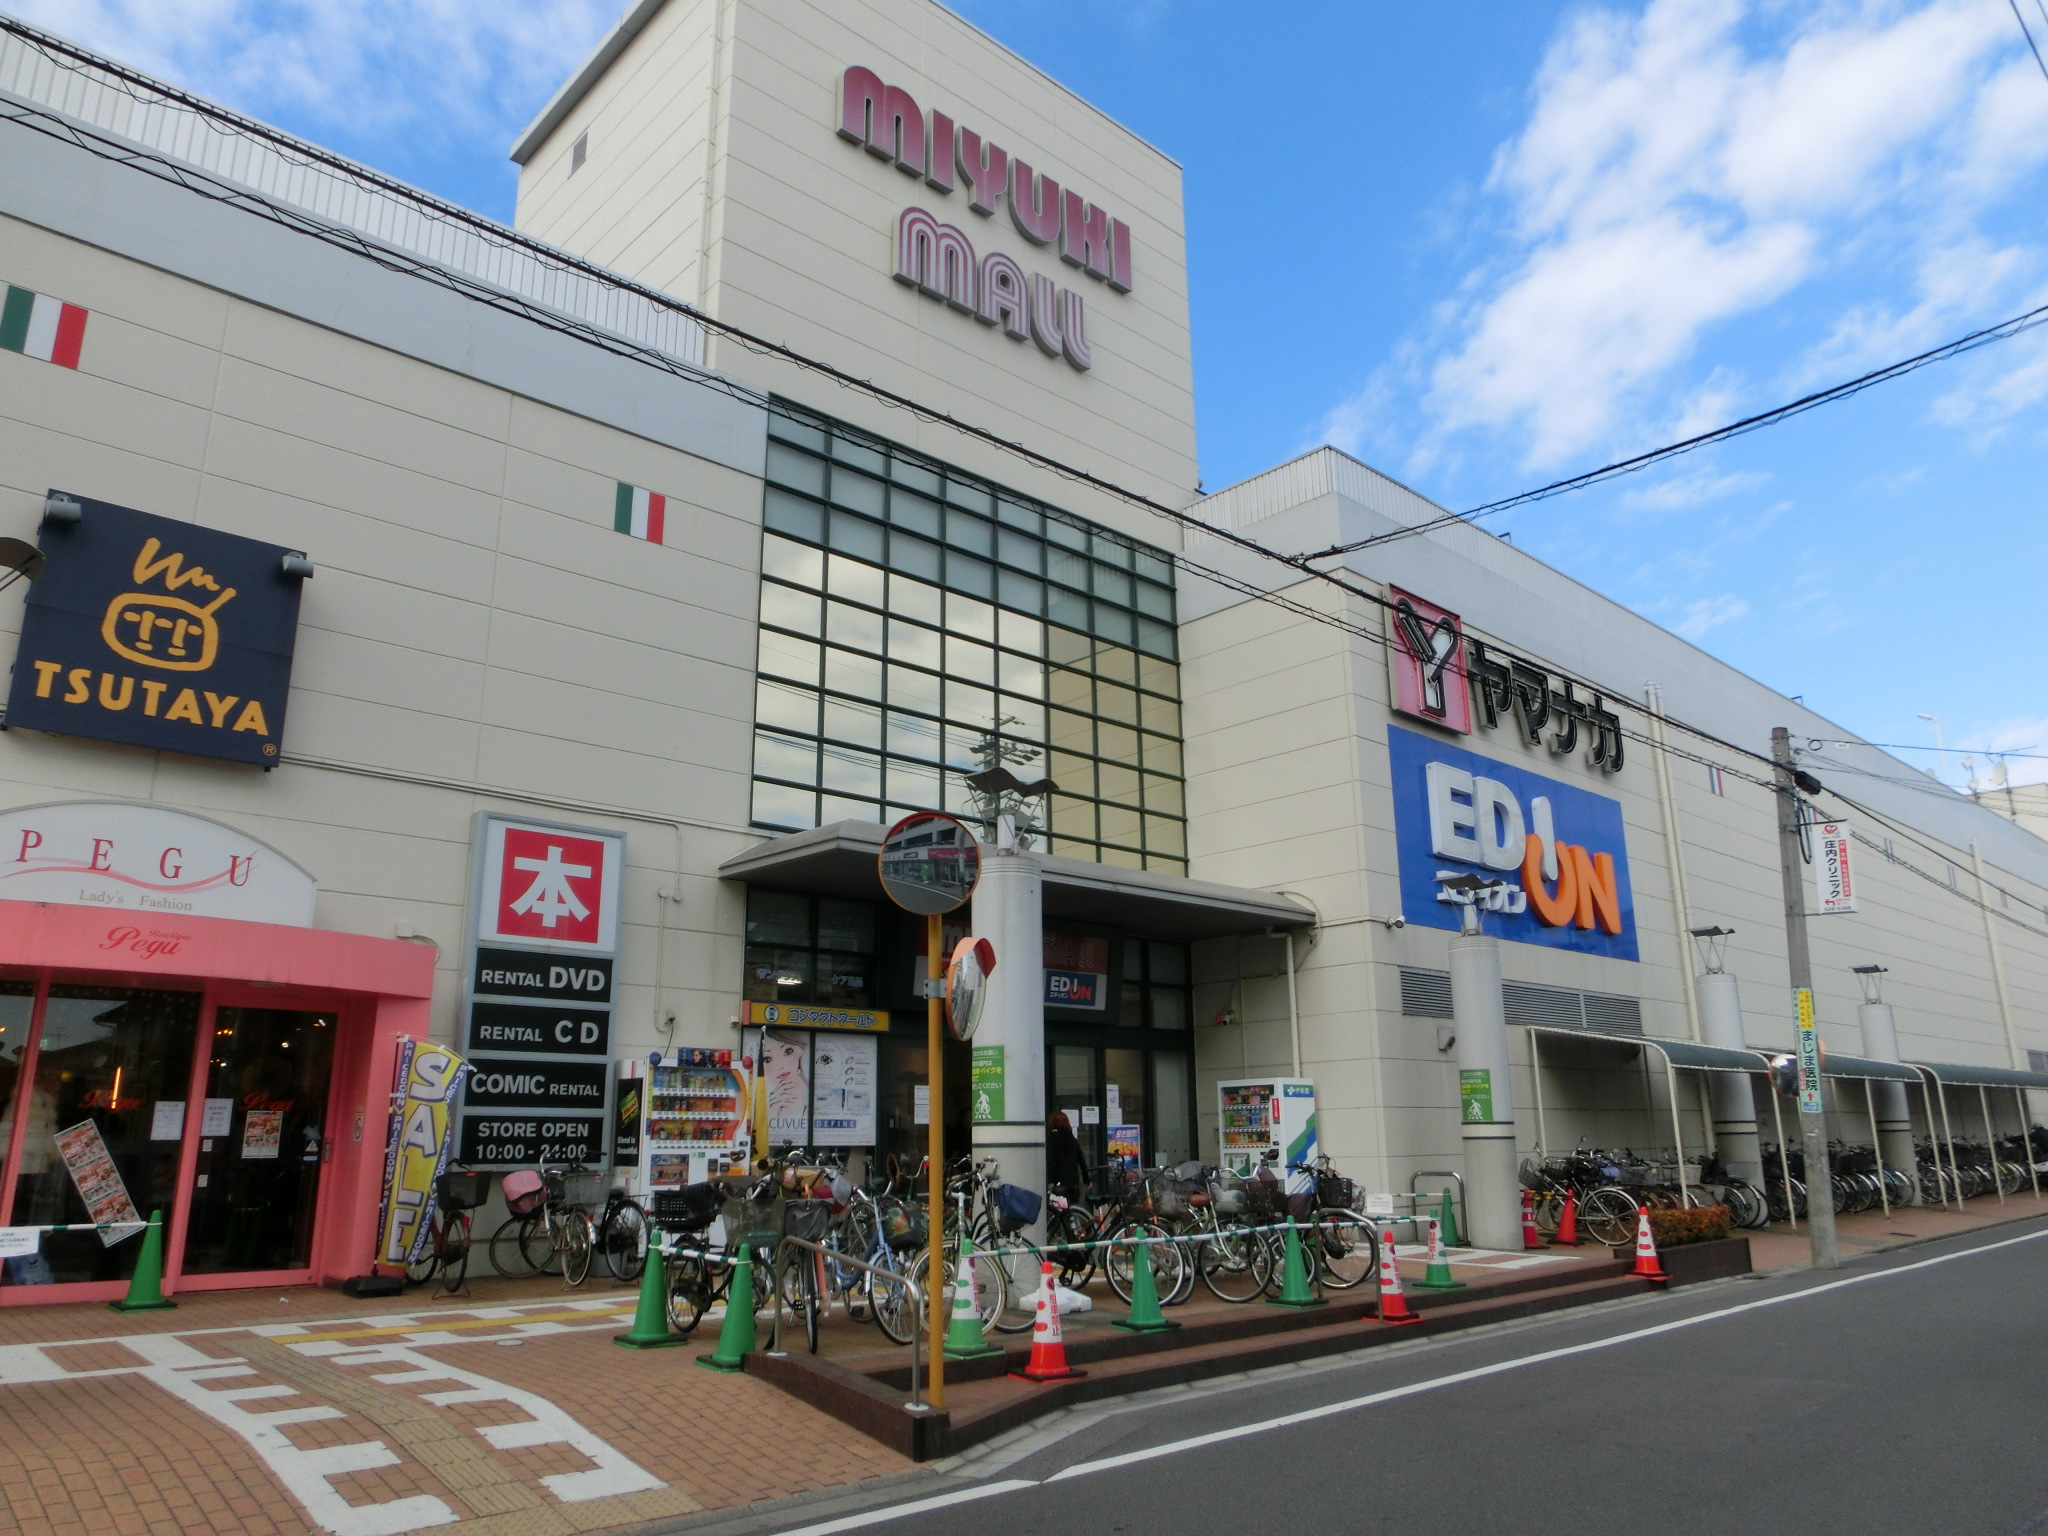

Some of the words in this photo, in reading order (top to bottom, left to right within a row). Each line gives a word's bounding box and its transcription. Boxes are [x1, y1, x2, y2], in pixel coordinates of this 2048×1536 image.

[836, 65, 1132, 294] MIYUKI
[892, 206, 1090, 372] MALL
[34, 660, 269, 736] TSUTAYA
[1467, 640, 1624, 773] ヤマナカ
[1426, 762, 1621, 935] EDION
[1824, 840, 1840, 898] 庄内クリニック
[79, 889, 124, 904] Lady's
[140, 895, 192, 911] Fashion
[509, 845, 592, 928] 本
[99, 926, 181, 960] Pegu
[481, 969, 544, 987] RENTAL
[549, 966, 605, 992] DVD
[1050, 976, 1092, 1000] EDION
[480, 1025, 543, 1042] RENTAL
[788, 1008, 877, 1028] コンタクトワールド
[1802, 1030, 1818, 1091] まじま医院
[470, 1073, 545, 1095] COMIC
[550, 1083, 600, 1096] RENTAL
[478, 1122, 537, 1137] STORE
[541, 1123, 588, 1138] OPEN
[816, 1120, 856, 1128] DEFINE
[387, 1052, 451, 1262] SALE
[476, 1144, 525, 1160] 10:00
[408, 1200, 434, 1263] PRICEDOWN
[1048, 1293, 1060, 1337] 駐車禁止
